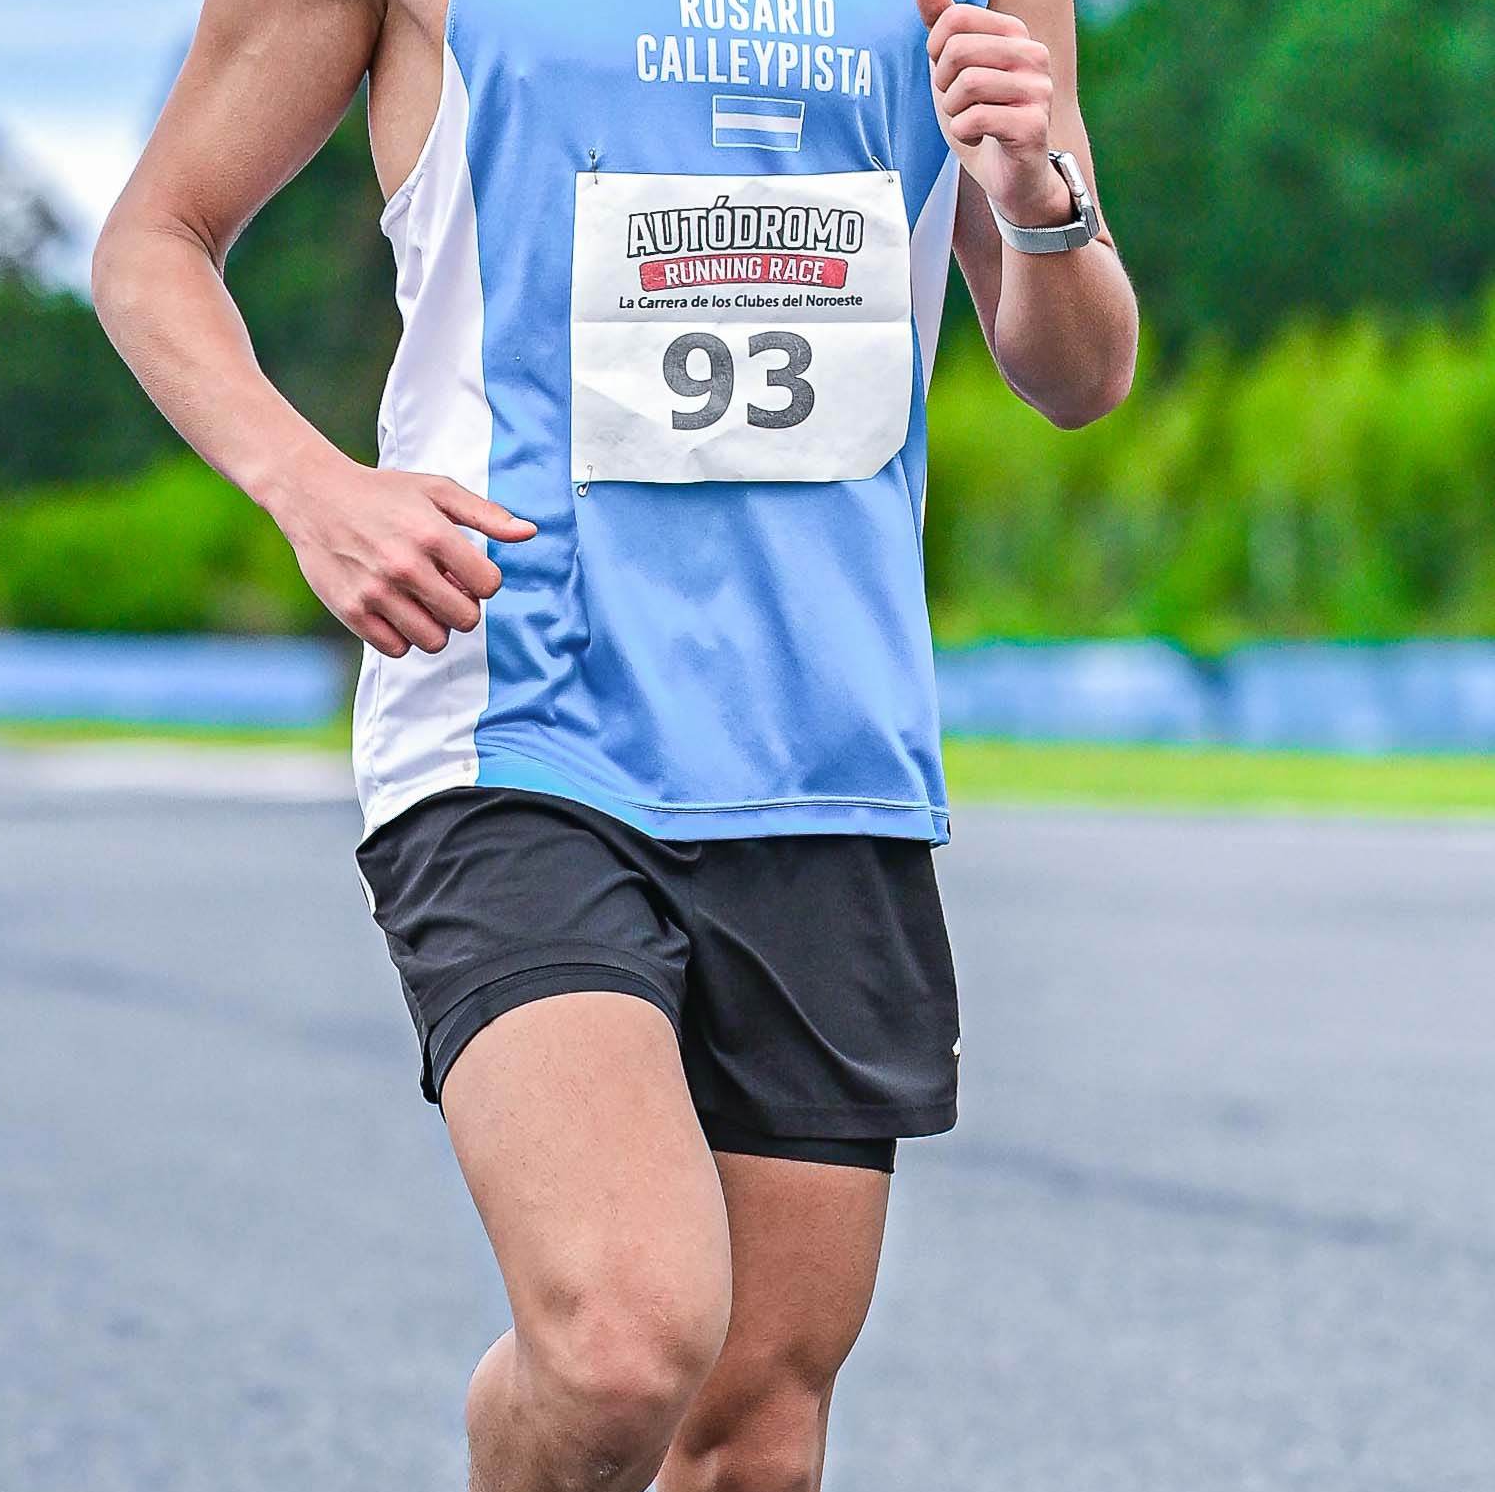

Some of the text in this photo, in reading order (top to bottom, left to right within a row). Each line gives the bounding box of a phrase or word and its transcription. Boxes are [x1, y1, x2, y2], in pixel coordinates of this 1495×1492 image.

[635, 32, 872, 97] CALLEYPISTA
[627, 195, 865, 259] AUTÓDROMO
[619, 293, 863, 309] La Carrera de los Clubes del Noroeste
[664, 257, 824, 286] RUNNING RACE
[662, 330, 816, 431] 93
